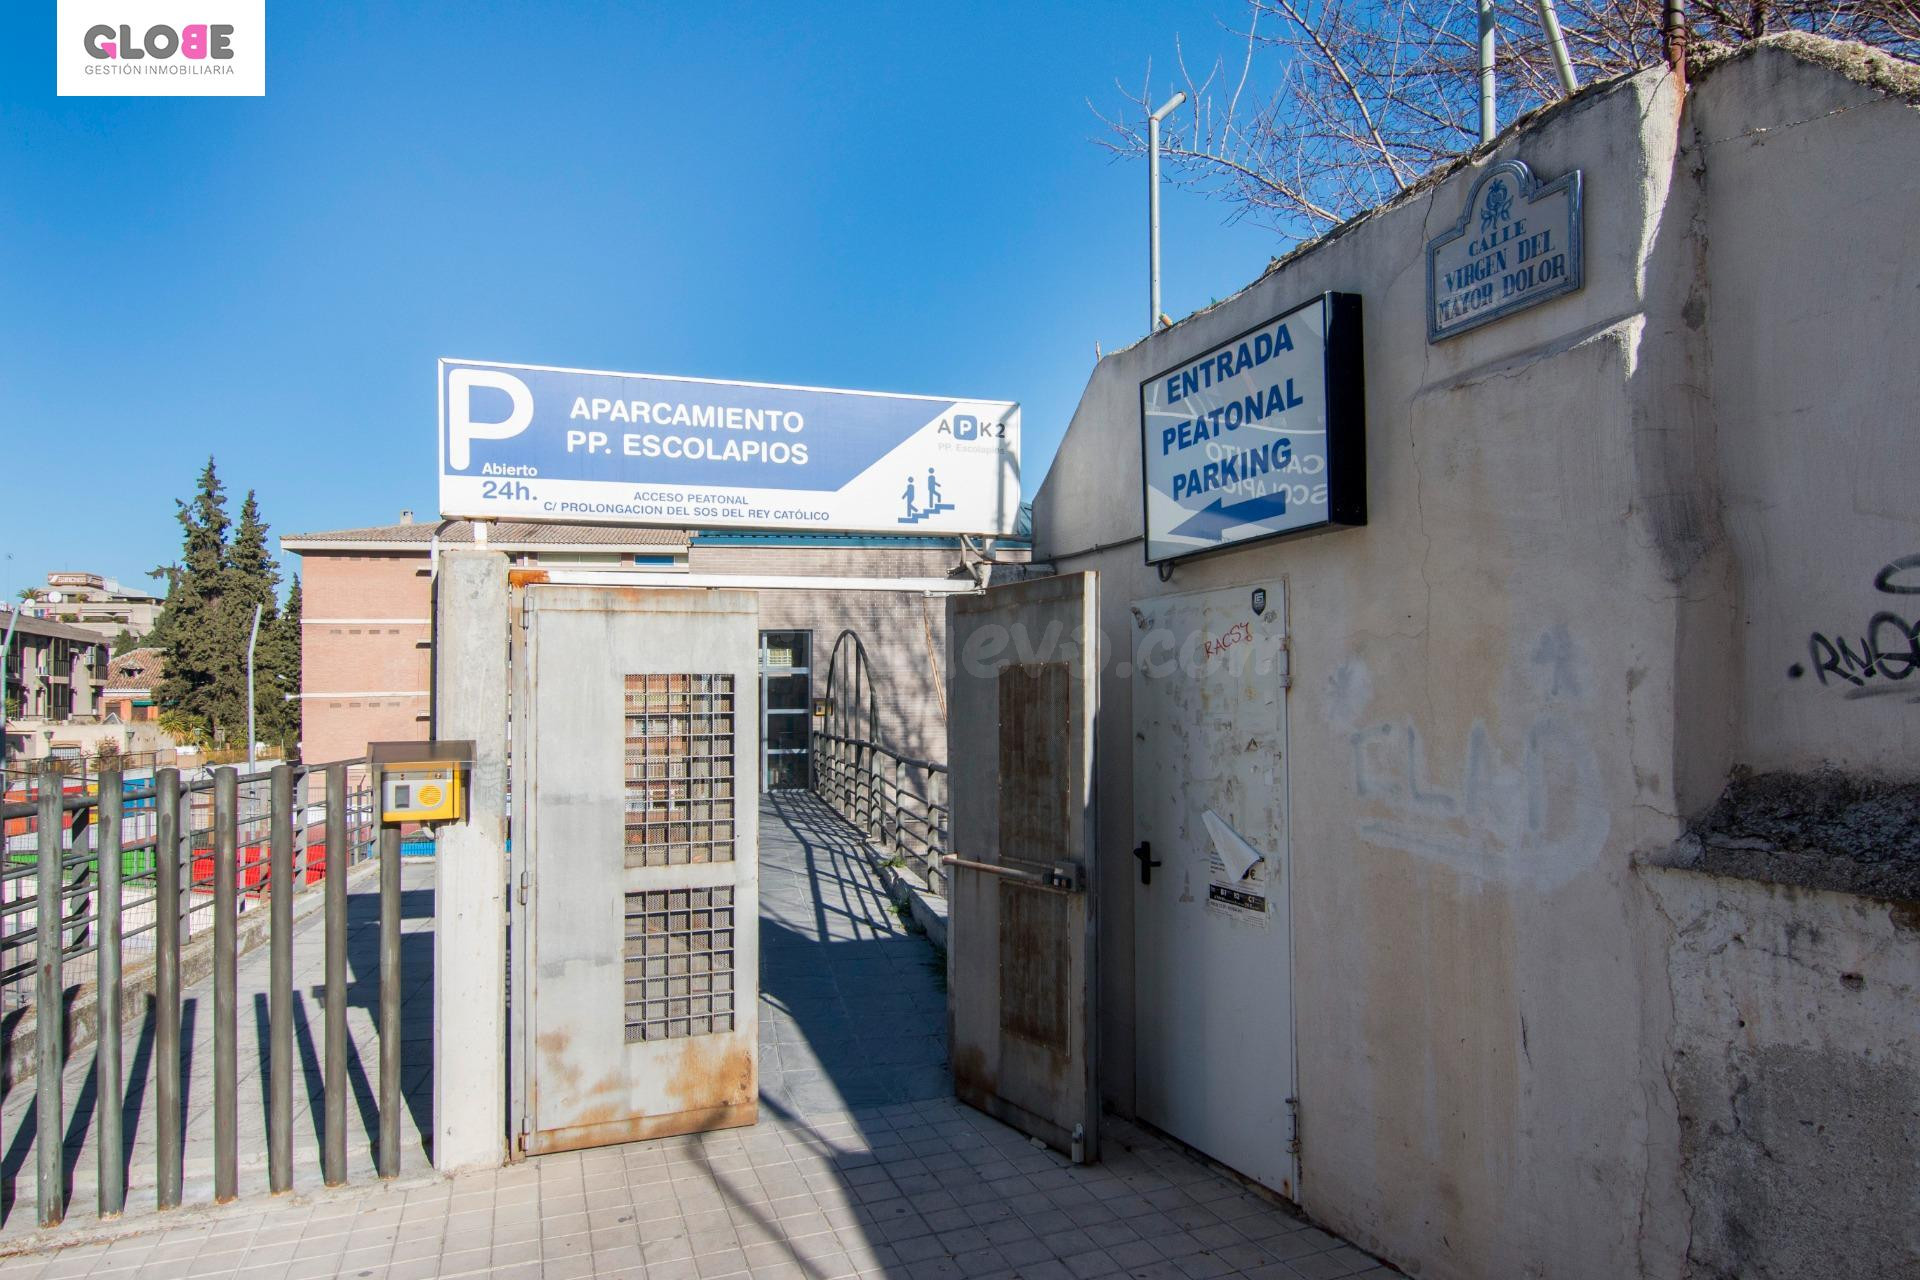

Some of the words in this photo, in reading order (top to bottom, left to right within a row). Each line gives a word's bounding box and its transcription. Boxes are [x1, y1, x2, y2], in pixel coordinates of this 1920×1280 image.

[1469, 218, 1526, 256] CALLE
[1445, 248, 1508, 292] VIRGEN
[1518, 229, 1555, 264] DEL
[1439, 283, 1493, 322] MAYOR
[1503, 254, 1565, 298] DOLOR
[1167, 323, 1294, 405] ENTRADA
[449, 369, 534, 470] P
[570, 397, 804, 433] APARCAMIENTO
[1162, 378, 1303, 456] PEATONAL
[567, 430, 611, 455] PP.
[623, 433, 809, 465] ESCOLAPIOS
[482, 462, 538, 477] Abierto
[1173, 437, 1292, 501] PARKING
[482, 481, 537, 500] 24h.
[634, 492, 683, 503] ACCESO
[687, 494, 749, 505] PEATONAL
[544, 501, 557, 512] C/
[561, 502, 662, 515] PROLONGACION
[667, 506, 690, 516] DEL
[694, 507, 718, 517] SOS
[722, 508, 745, 518] DEL
[748, 509, 770, 519] REY
[774, 509, 830, 521] CATÓLICO
